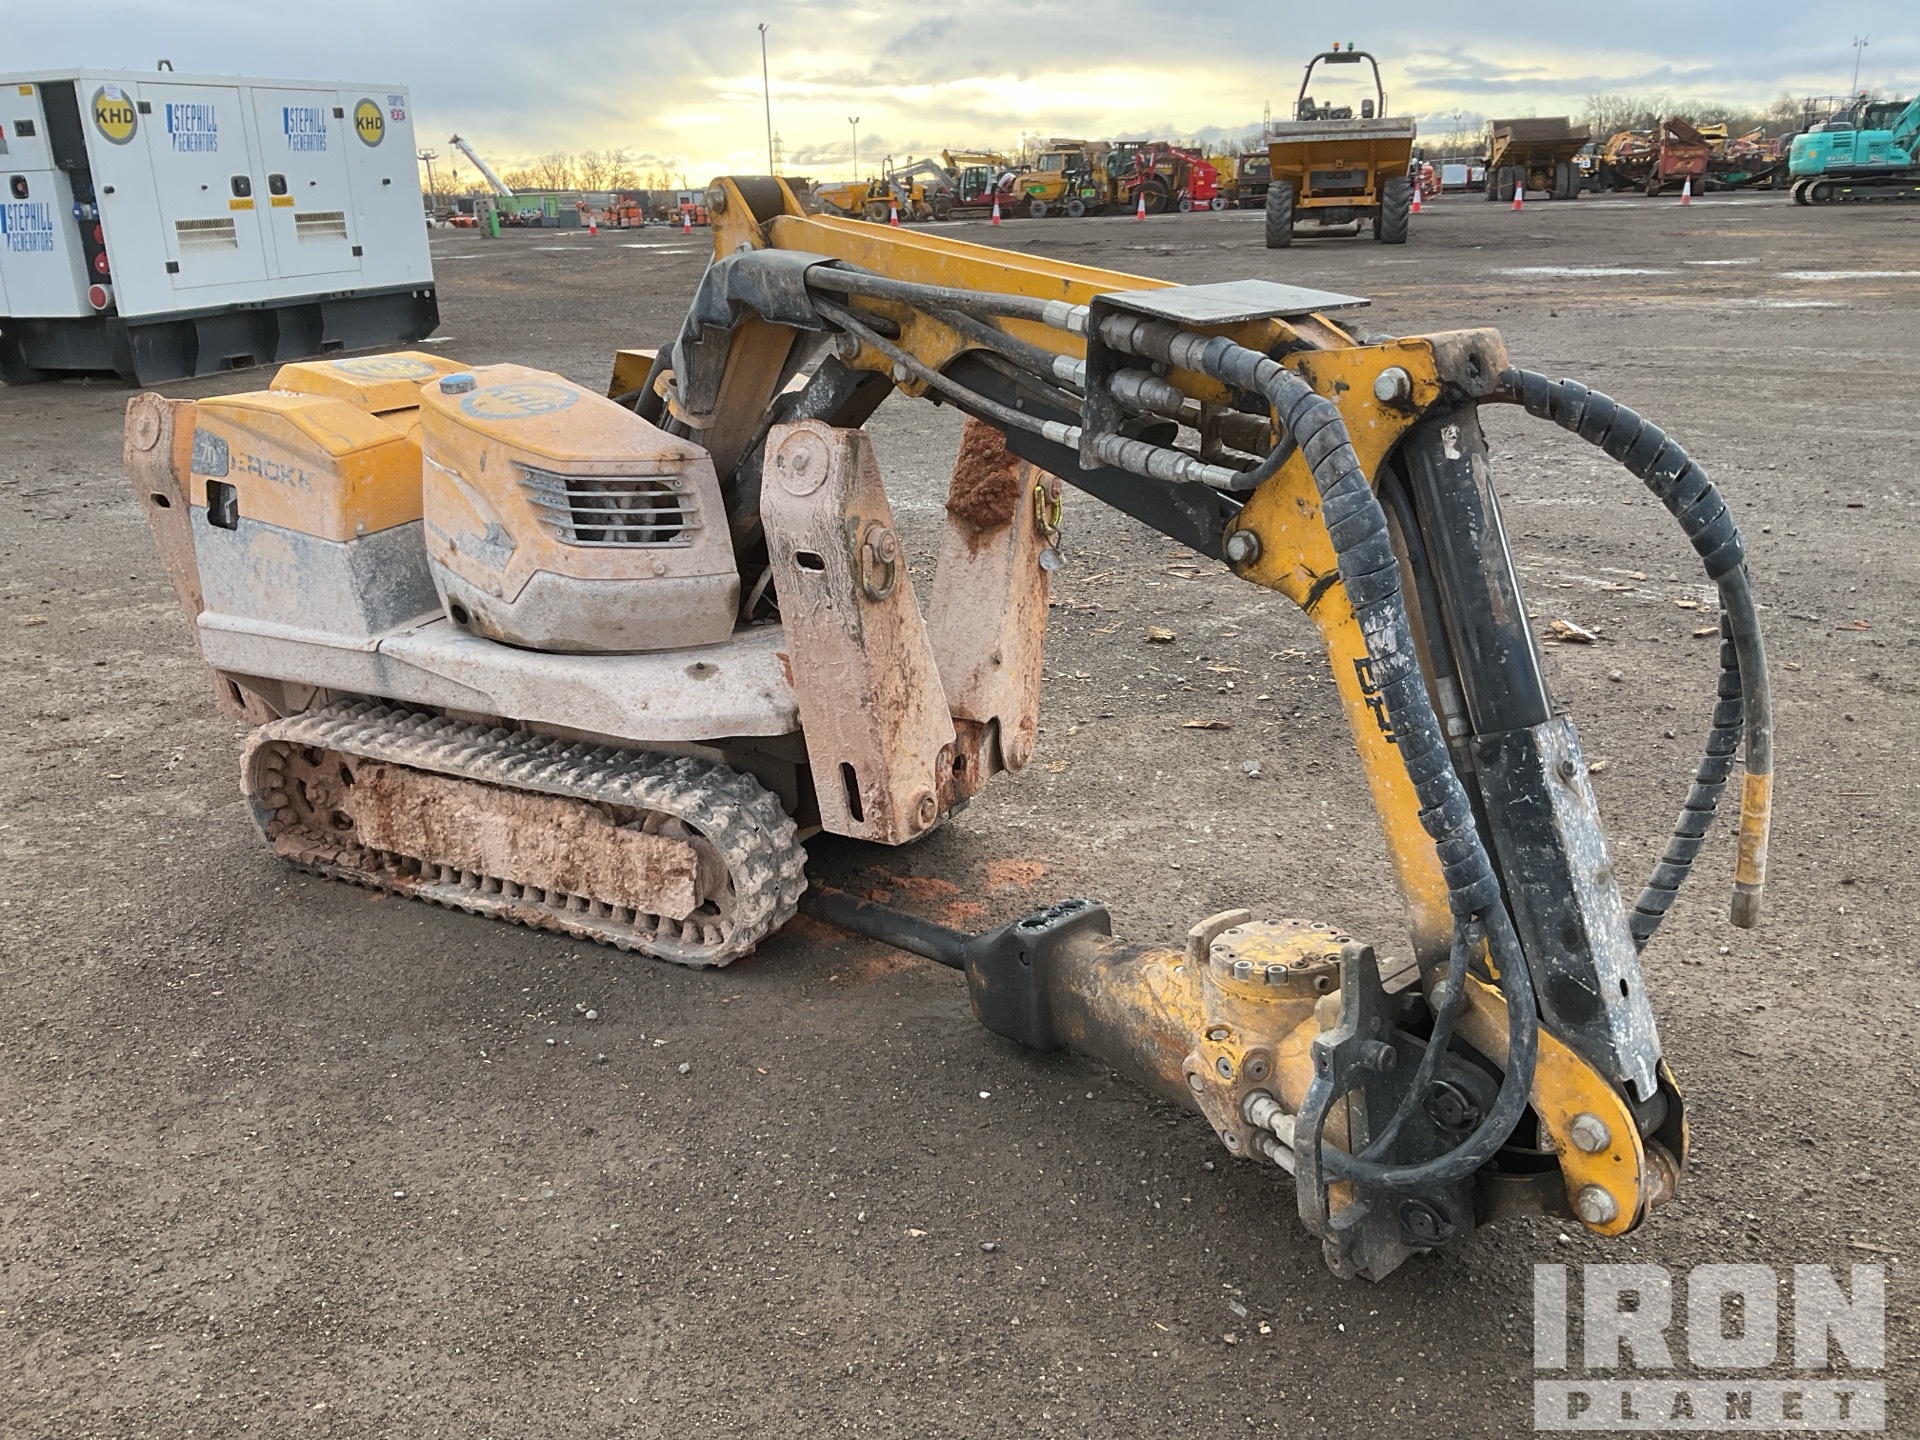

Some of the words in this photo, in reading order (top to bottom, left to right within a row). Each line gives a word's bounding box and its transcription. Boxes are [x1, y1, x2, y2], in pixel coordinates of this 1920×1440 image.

[95, 107, 134, 124] KHD
[173, 104, 217, 132] STEPHILL
[290, 107, 326, 133] STEPHILL
[356, 117, 383, 130] KHD
[178, 132, 218, 152] GENERATORS
[293, 133, 326, 152] GENERATORS
[7, 202, 53, 231] STEPHILL
[12, 231, 54, 252] GENERATORS
[200, 442, 217, 464] 70
